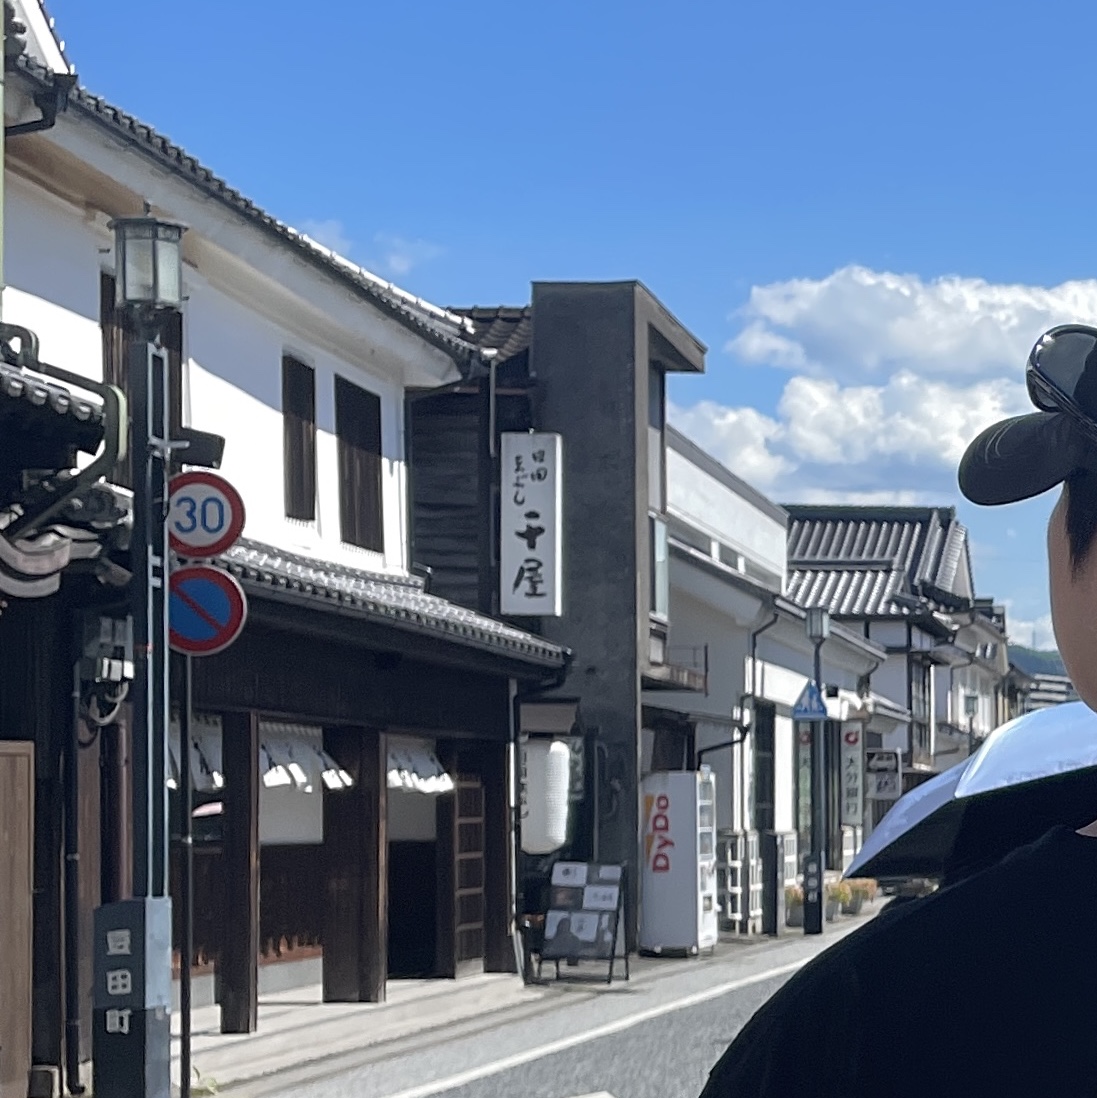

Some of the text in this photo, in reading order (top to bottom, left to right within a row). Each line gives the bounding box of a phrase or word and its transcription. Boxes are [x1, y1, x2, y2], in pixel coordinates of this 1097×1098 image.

[530, 449, 548, 483] 日田
[174, 496, 224, 534] 30
[652, 795, 675, 873] DyDo
